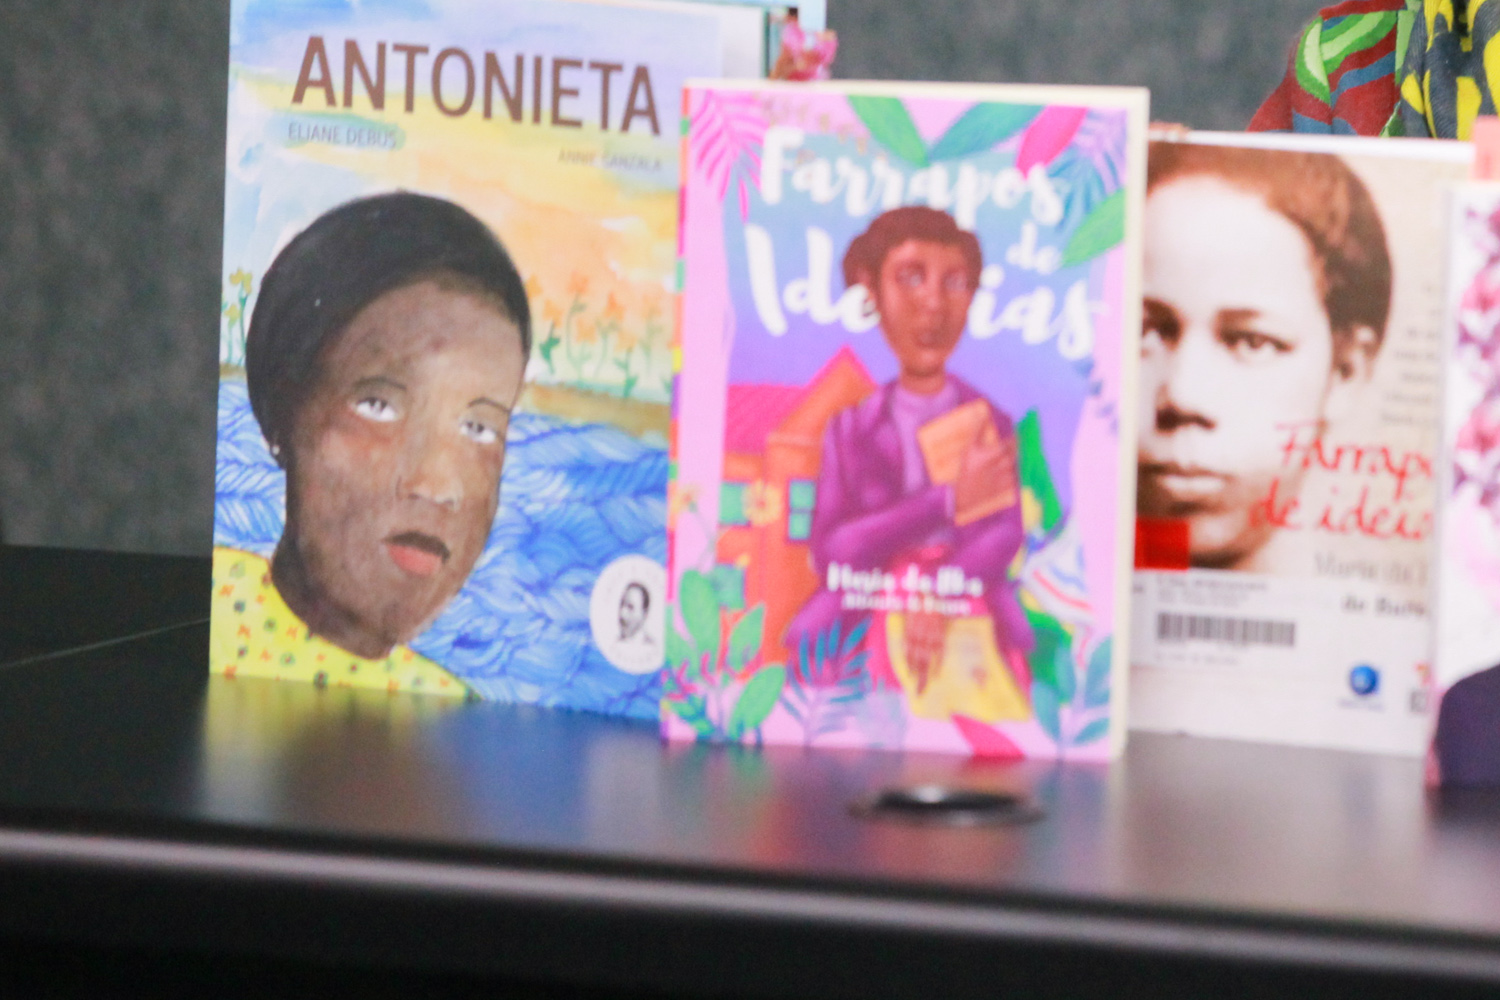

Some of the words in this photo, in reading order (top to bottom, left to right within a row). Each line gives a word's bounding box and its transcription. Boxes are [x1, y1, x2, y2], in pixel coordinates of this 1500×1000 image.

[291, 34, 661, 136] ANTONIETA
[288, 120, 341, 144] ELIANE
[761, 127, 1067, 230] Farrapos
[1005, 219, 1063, 275] de
[1251, 476, 1301, 532] de
